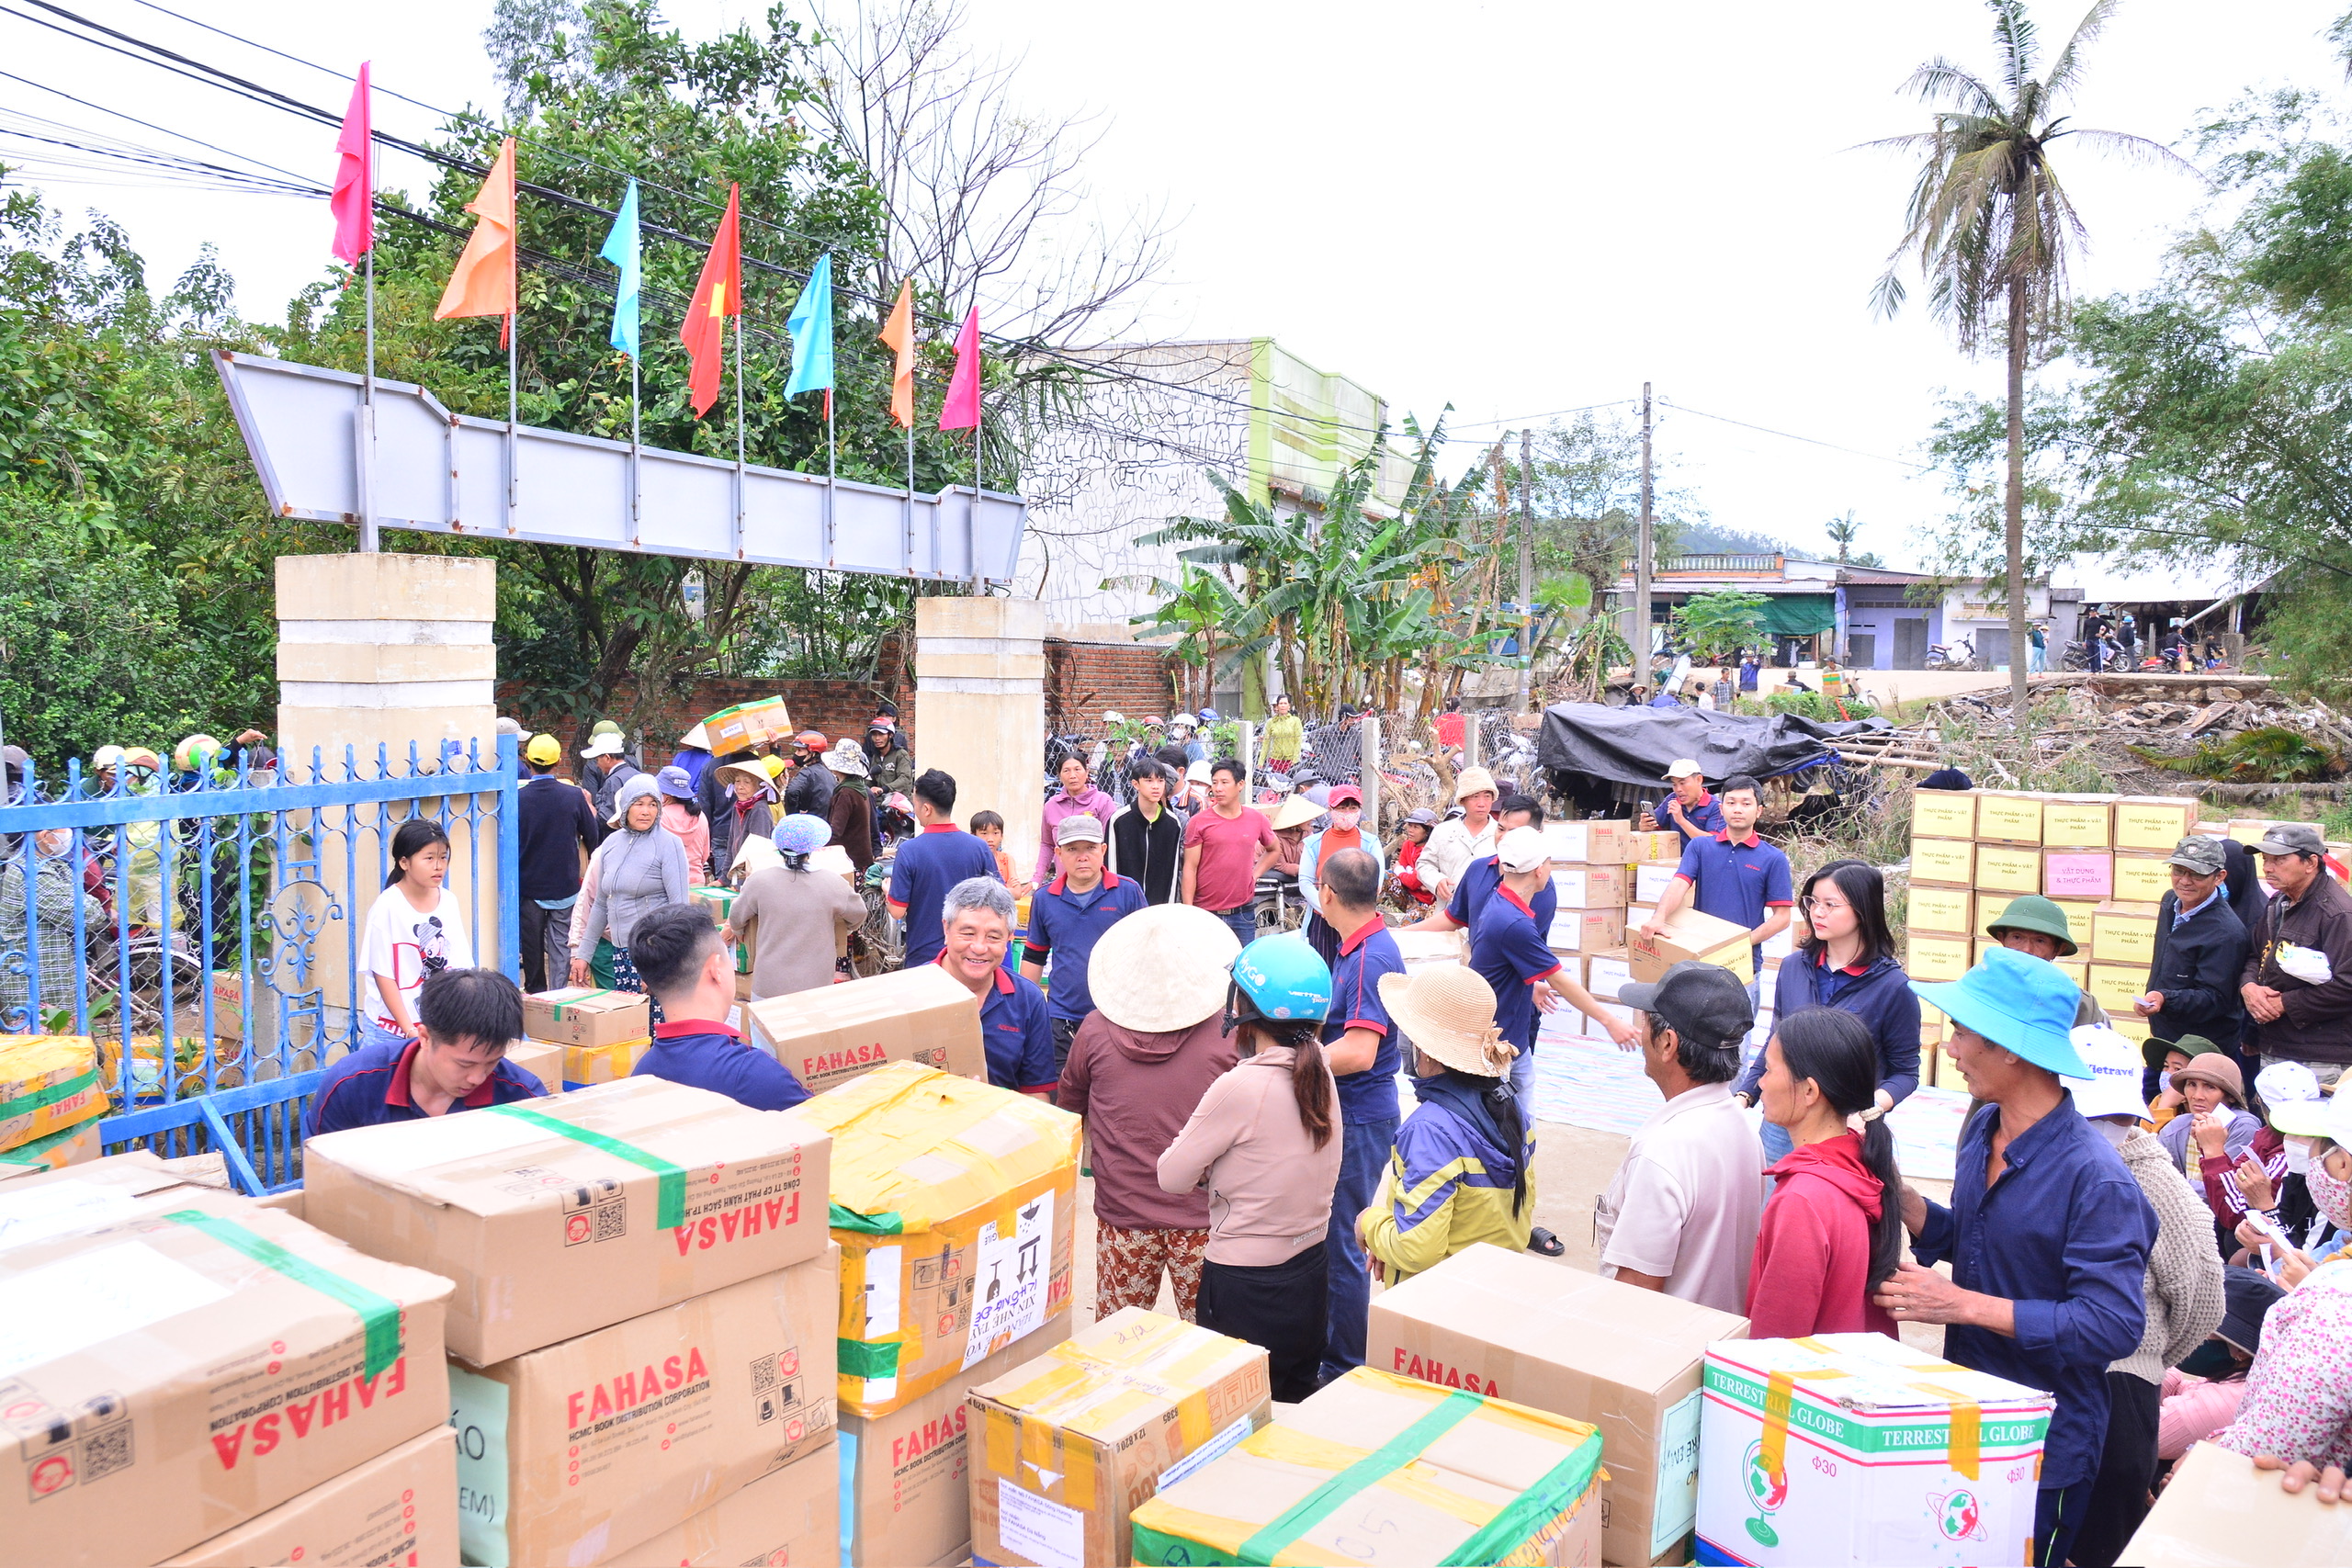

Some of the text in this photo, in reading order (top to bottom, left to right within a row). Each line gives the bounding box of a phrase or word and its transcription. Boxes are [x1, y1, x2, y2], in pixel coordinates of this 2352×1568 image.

[803, 1043, 887, 1075] FAHASA
[831, 1066, 859, 1076] DISTRIBUTION
[859, 1059, 888, 1070] CORPORATION
[763, 1186, 772, 1195] CP
[774, 1185, 782, 1193] TY
[673, 1191, 800, 1257] FAHASA
[1017, 1293, 1036, 1314] XIN
[970, 1319, 990, 1341] TAY
[286, 1366, 351, 1401] DISTRIBUTION
[568, 1347, 708, 1429] FAHASA
[1394, 1347, 1499, 1398] FAHASA
[209, 1393, 283, 1432] CORPORATION
[210, 1357, 405, 1470] FAHASA
[569, 1380, 710, 1443] HCMC BOOK DISTRIBUTION CORPORATION
[1713, 1371, 1844, 1438] TERRESTRIAL GLOBE
[892, 1404, 967, 1468] FAHAS
[1121, 1438, 1134, 1451] 820
[1139, 1427, 1147, 1439] 12
[1882, 1424, 2035, 1447] TERRESTRIAL GLOBE
[894, 1464, 910, 1478] HCMC
[910, 1457, 923, 1470] BOOK
[923, 1440, 955, 1462] DISTRIBUTION
